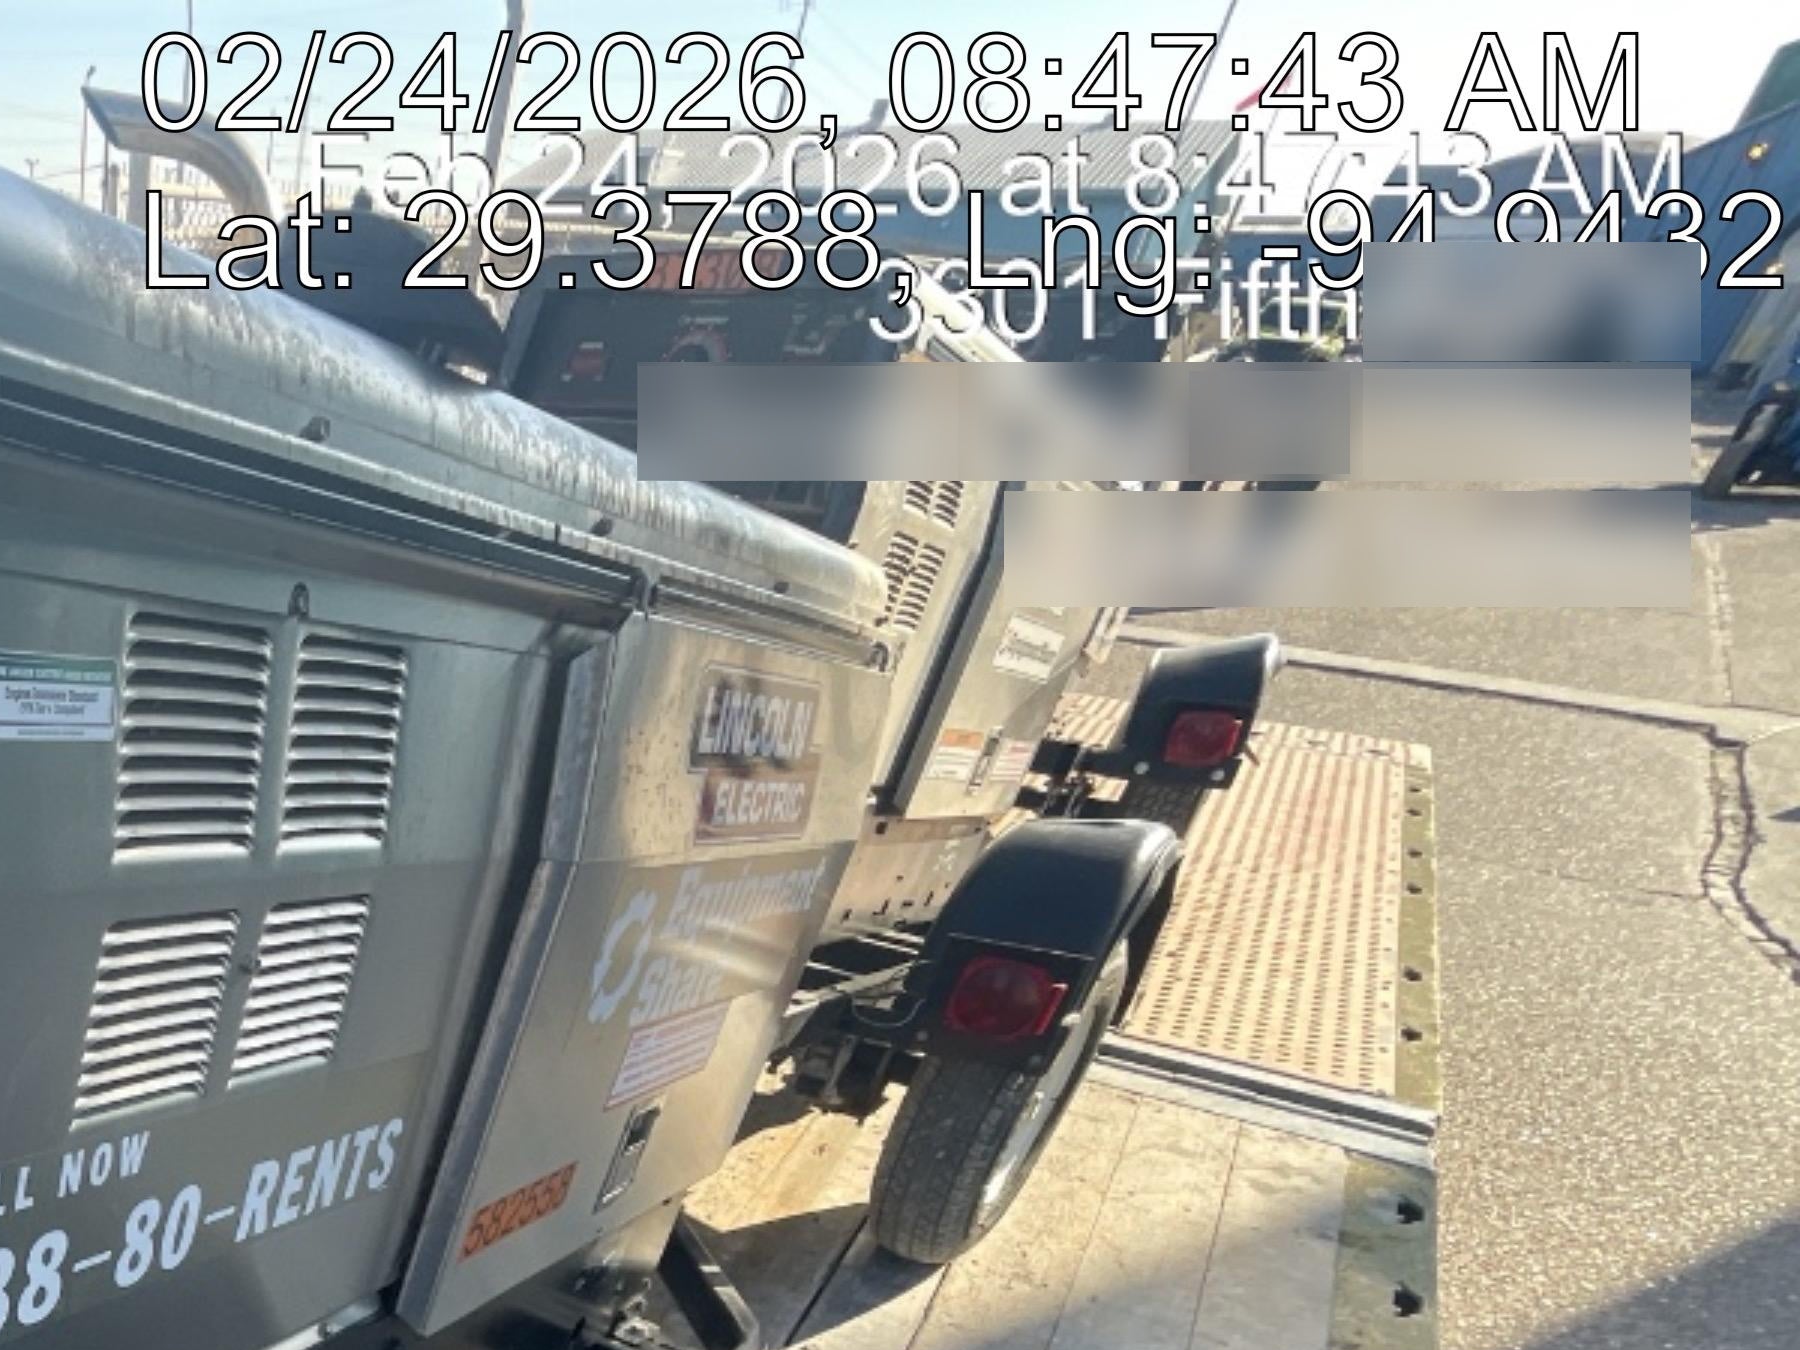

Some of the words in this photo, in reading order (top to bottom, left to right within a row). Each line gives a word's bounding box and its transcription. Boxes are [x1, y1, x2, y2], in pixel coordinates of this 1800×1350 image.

[696, 685, 816, 762] LINCOLN
[710, 777, 807, 827] ELECTRIC
[660, 855, 827, 942] Equipment
[57, 1130, 151, 1198] NOW
